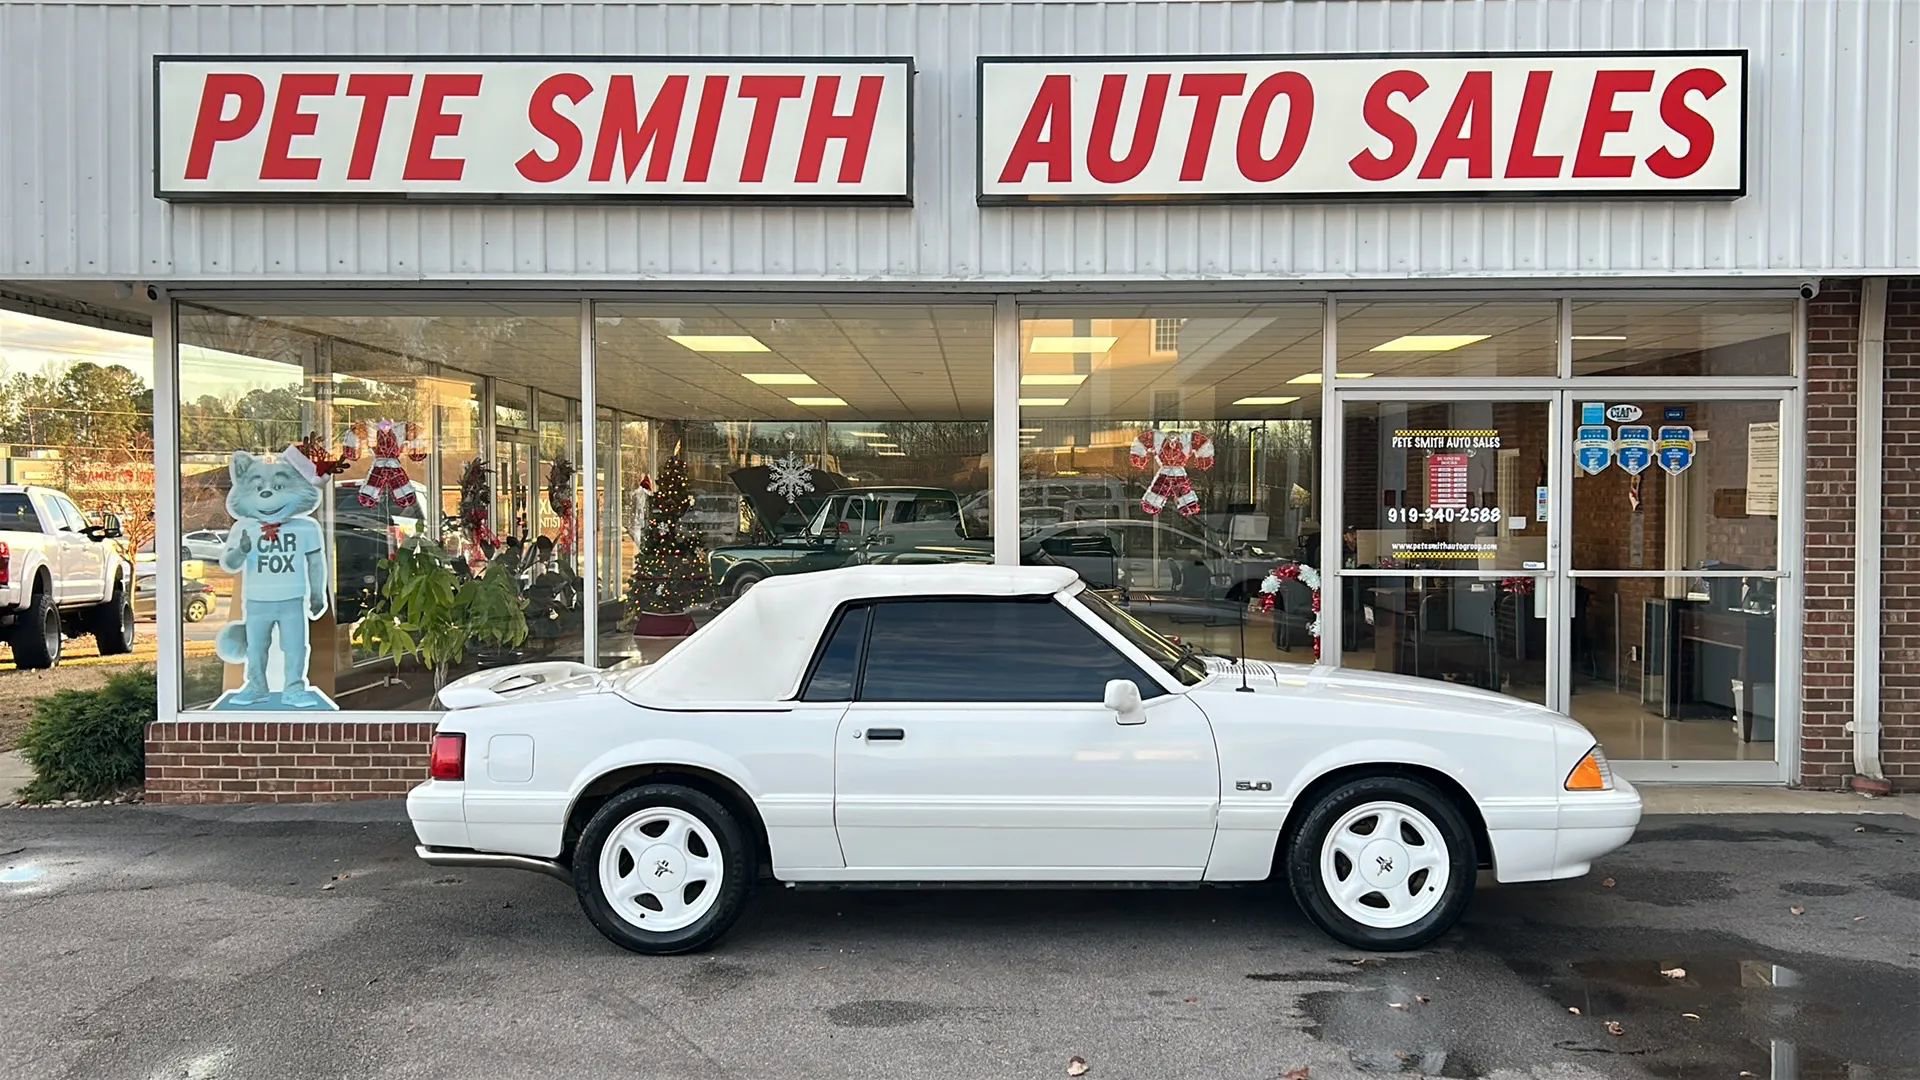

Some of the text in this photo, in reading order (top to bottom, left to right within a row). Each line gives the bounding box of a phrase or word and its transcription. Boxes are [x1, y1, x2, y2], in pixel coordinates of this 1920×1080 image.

[184, 72, 885, 184] PETE SMITH
[998, 68, 1727, 183] AUTO SALES
[1392, 437, 1501, 448] PETE SMITH AUTO SALES
[1388, 507, 1502, 523] 919-340-2588
[257, 533, 297, 553] CAR
[257, 554, 296, 574] FOX
[1235, 780, 1273, 791] 5.0
